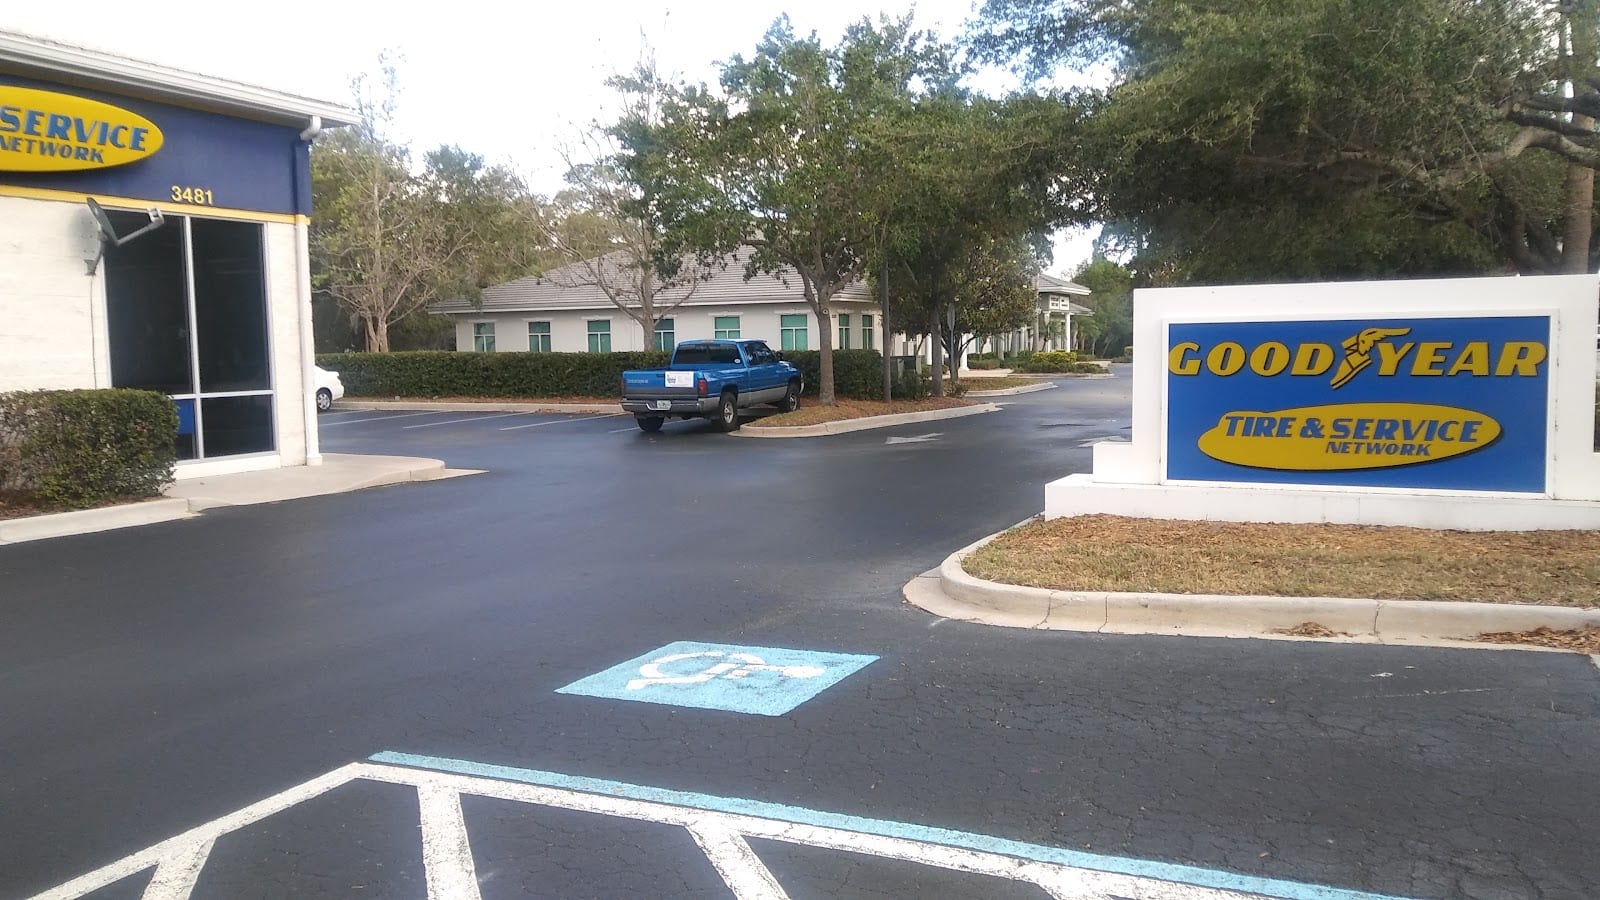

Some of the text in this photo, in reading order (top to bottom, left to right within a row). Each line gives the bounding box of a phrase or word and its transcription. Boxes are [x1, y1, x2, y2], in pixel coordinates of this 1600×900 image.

[0, 105, 148, 151] SERVICE
[0, 134, 105, 164] NETWORK
[171, 185, 214, 206] 3481
[1225, 416, 1483, 443] TIRE & SERVICE
[1325, 441, 1431, 457] NETWORK
